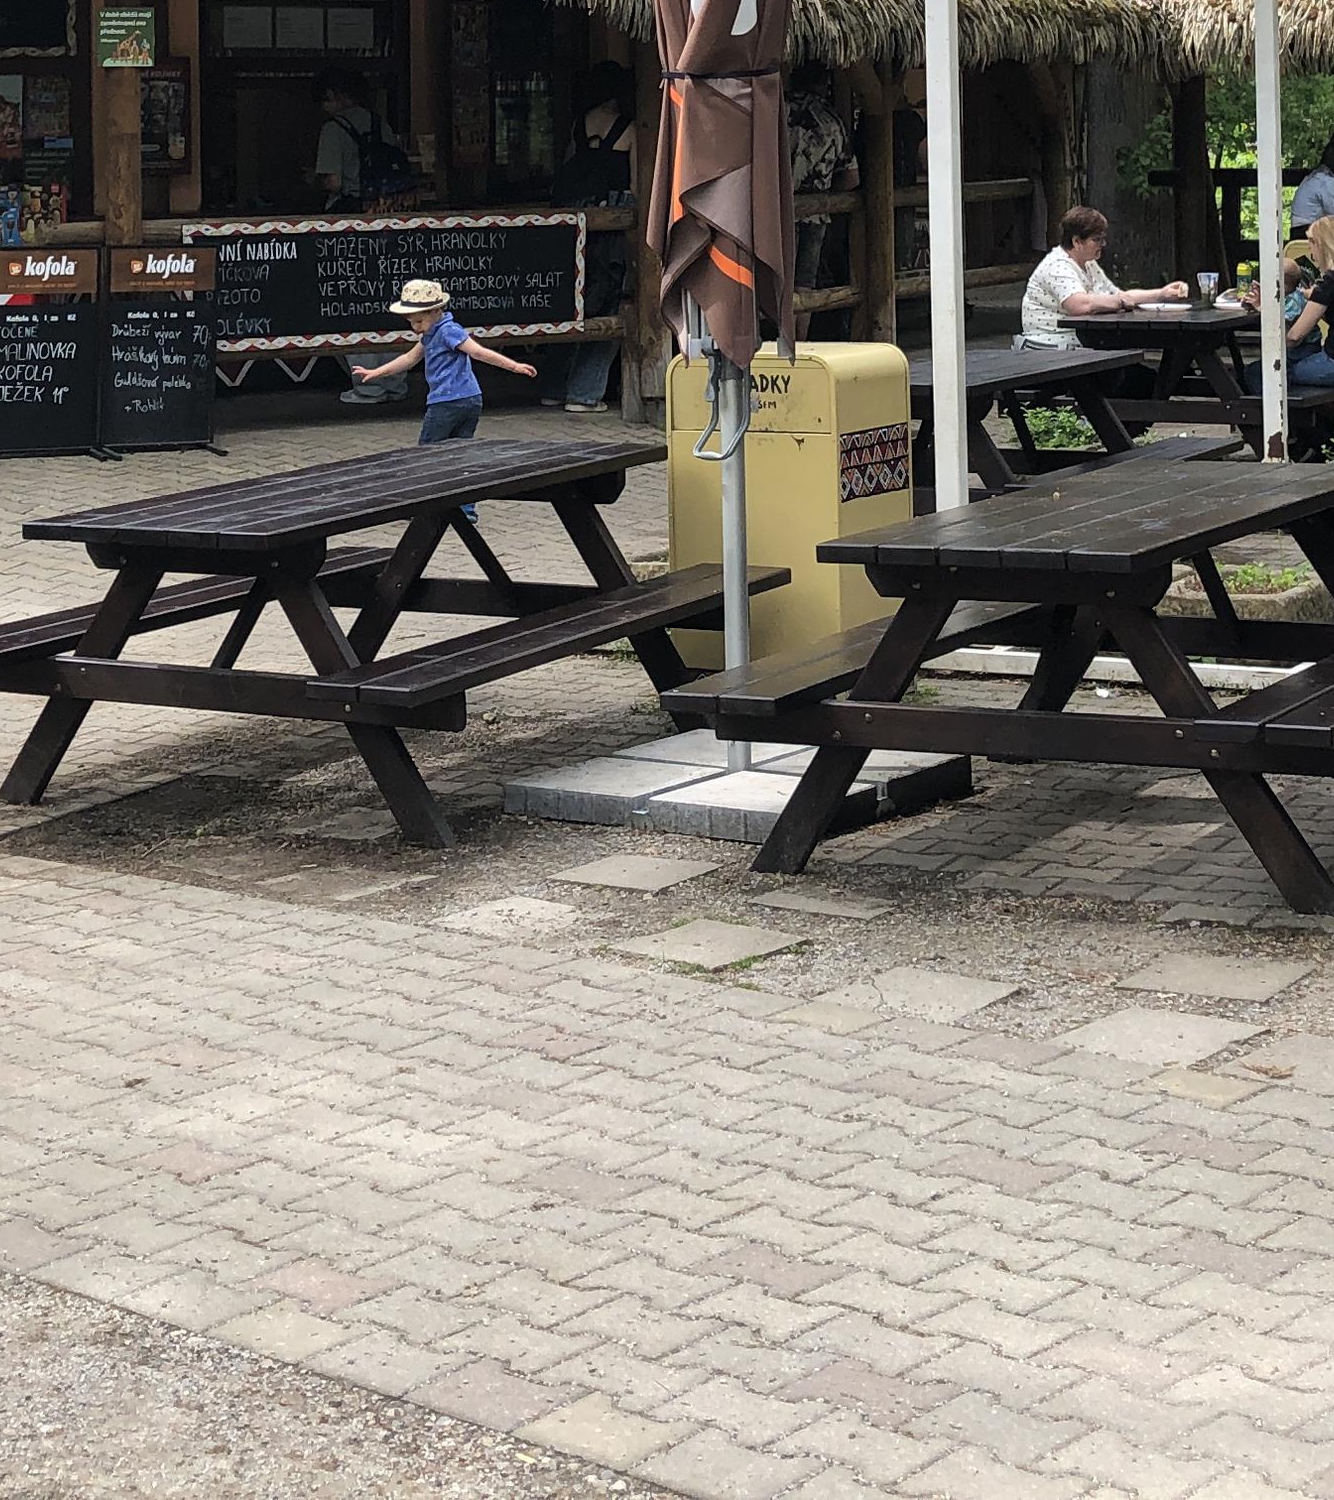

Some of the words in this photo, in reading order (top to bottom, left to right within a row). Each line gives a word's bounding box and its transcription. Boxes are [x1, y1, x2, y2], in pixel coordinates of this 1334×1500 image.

[246, 238, 298, 261] NABÍDKA
[24, 256, 76, 281] kofola
[145, 254, 195, 279] kofola
[377, 254, 418, 275] ŘÍZEK
[425, 256, 494, 274] HRANOLKY
[319, 275, 386, 297] VEPŘOVÝ
[320, 297, 393, 317] HOLANDSK
[520, 290, 553, 308] KAŠE
[111, 323, 152, 338] Drůbeží
